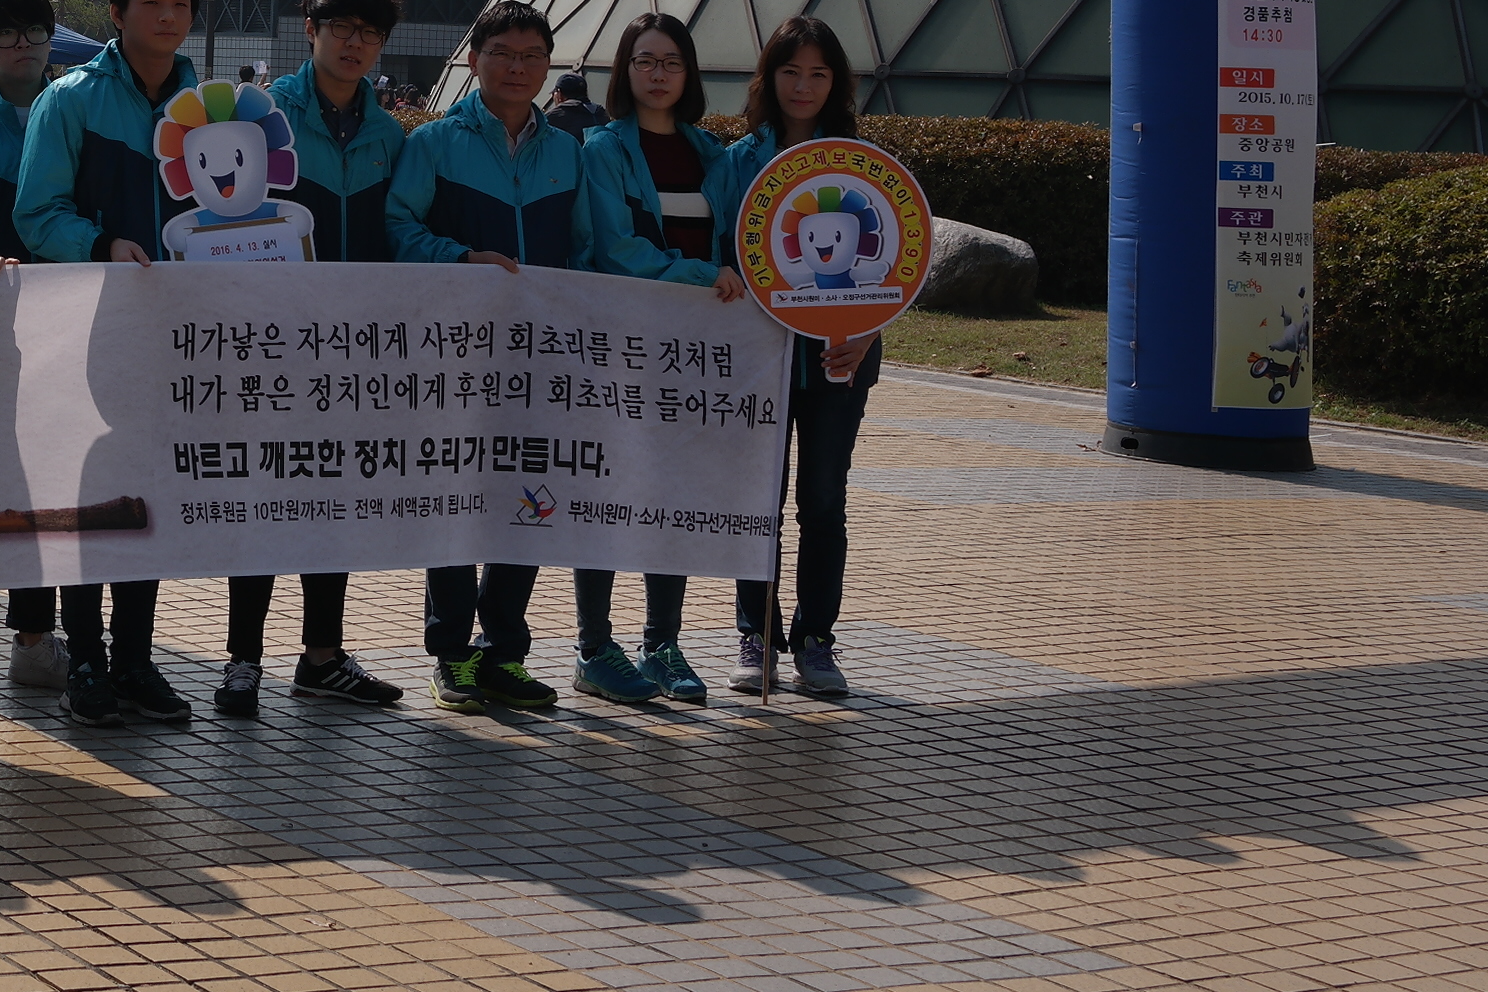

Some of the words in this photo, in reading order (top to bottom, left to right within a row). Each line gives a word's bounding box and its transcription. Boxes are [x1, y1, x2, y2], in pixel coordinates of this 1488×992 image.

[1243, 6, 1293, 24] 경품추첨
[1242, 28, 1283, 43] 14:30
[1232, 70, 1264, 86] 일시
[1238, 91, 1276, 105] 2015.
[1232, 117, 1264, 132] 장소
[1238, 137, 1295, 154] 중앙공원
[1230, 163, 1263, 180] 주최
[1237, 183, 1283, 200] 부천시
[1229, 210, 1264, 226] 주관
[1237, 250, 1303, 267] 축제위원회
[1227, 278, 1263, 294] Fantasia
[296, 321, 409, 361] 자식에게
[420, 321, 495, 360] 사랑의
[506, 321, 612, 368] 회초리를
[620, 335, 648, 371] 든
[658, 338, 733, 379] 것처럼
[170, 374, 227, 415] 내가
[236, 374, 296, 413] 뽑은
[306, 372, 446, 412] 정치인에게
[453, 371, 533, 410] 후원의
[547, 373, 645, 419] 회초리를
[655, 387, 778, 430] 들어주세요
[173, 442, 250, 481] 바르고
[259, 438, 345, 480] 깨끗한
[354, 437, 406, 479] 정치
[416, 436, 486, 476] 우리가
[492, 436, 611, 479] 만듭니다.
[180, 501, 248, 525] 정치후원금
[253, 498, 347, 523] 10만원까지는
[354, 498, 383, 520] 전액
[390, 495, 444, 519] 세액공제
[447, 493, 488, 516] 됩니다.
